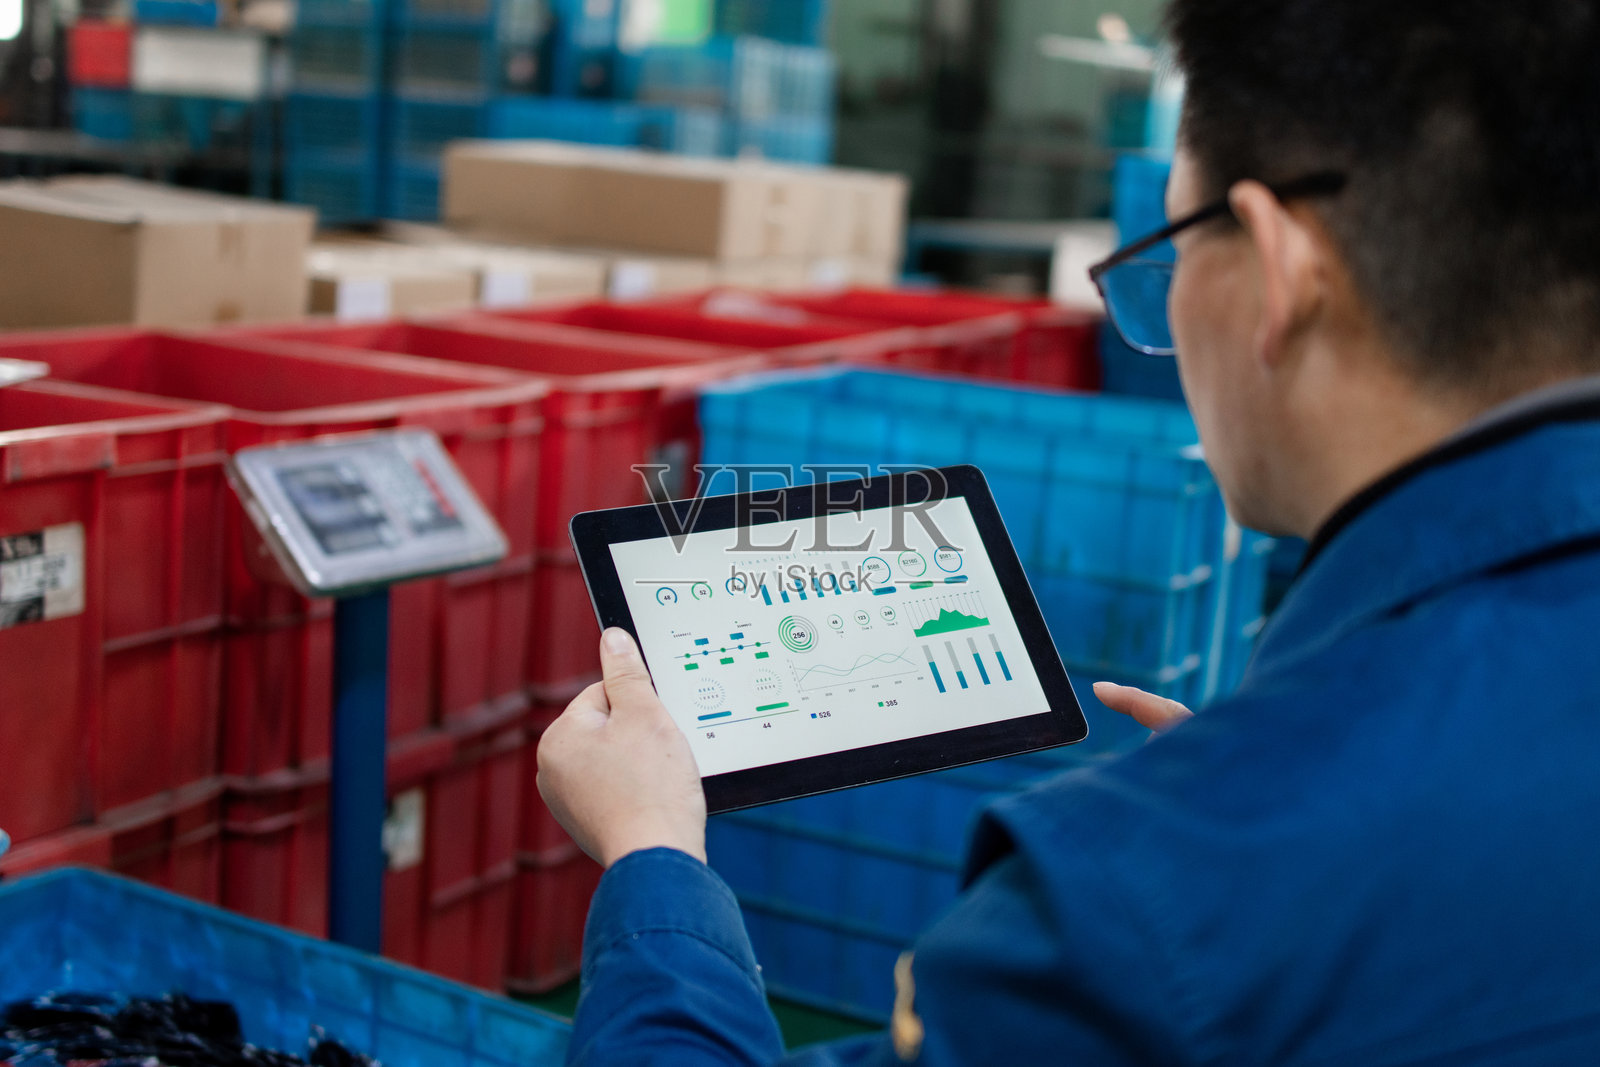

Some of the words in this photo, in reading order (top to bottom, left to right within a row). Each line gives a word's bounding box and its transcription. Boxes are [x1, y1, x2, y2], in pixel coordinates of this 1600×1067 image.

[792, 631, 806, 640] 256
[885, 699, 898, 708] 385
[818, 710, 832, 719] 526
[762, 722, 772, 730] 44
